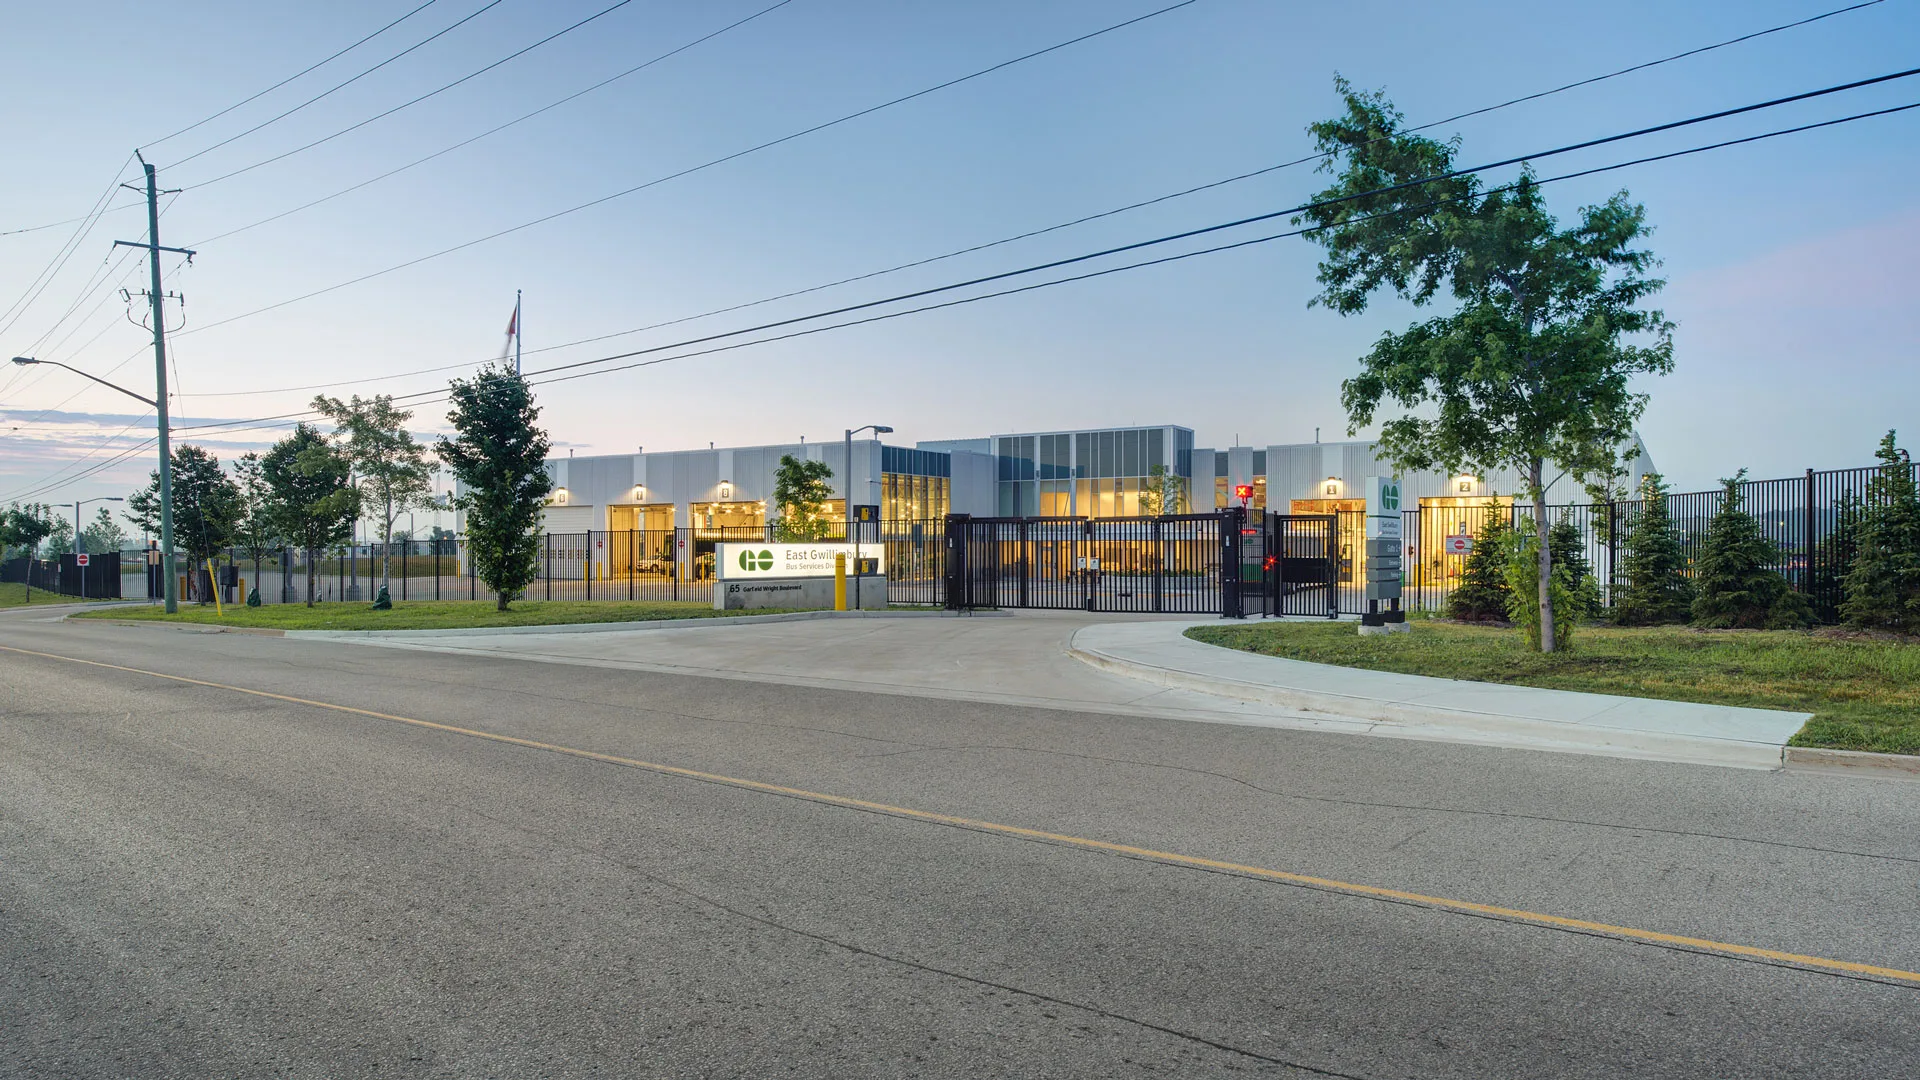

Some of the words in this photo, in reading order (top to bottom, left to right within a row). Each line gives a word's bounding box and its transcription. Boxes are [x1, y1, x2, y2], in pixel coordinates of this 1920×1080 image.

[738, 549, 774, 571] GO
[786, 550, 807, 560] East
[729, 584, 740, 593] 65
[763, 585, 779, 593] Wright
